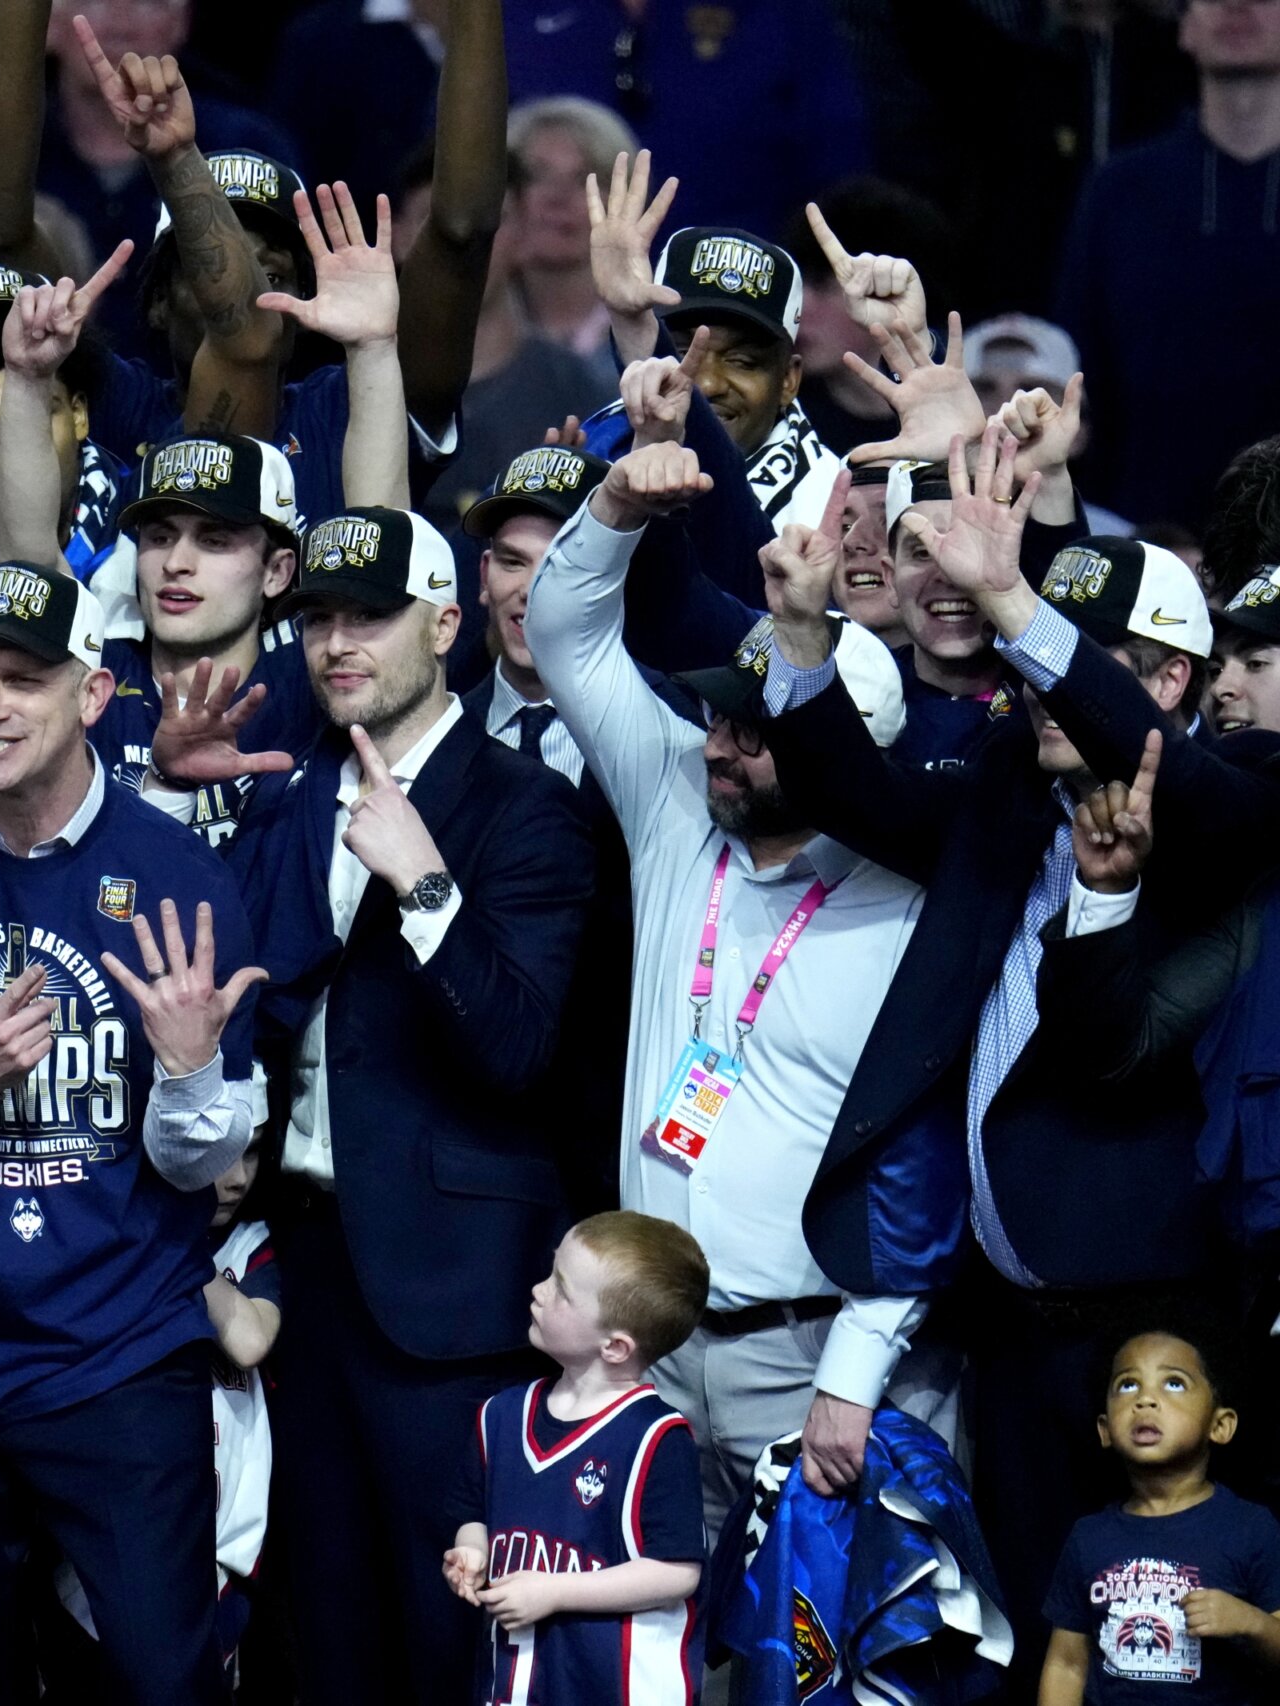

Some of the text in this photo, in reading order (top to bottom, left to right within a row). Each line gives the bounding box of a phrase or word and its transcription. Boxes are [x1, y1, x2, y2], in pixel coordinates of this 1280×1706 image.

[208, 159, 278, 198] HAMPS
[690, 239, 774, 294] CHAMPS
[151, 445, 233, 488] CHAMPS
[502, 455, 585, 490] CHAMPS
[306, 521, 381, 568] CHAMPS
[1040, 552, 1112, 598] CHAMPS
[104, 894, 128, 906] FOUR
[105, 885, 128, 896] FINAL
[706, 878, 724, 925] THE ROAD
[772, 910, 807, 958] PHX24
[29, 926, 114, 1016] BASKETBALL
[15, 1140, 27, 1153] OF
[1090, 1580, 1204, 1603] CHAMPION
[1106, 1572, 1191, 1586] 2023 NATIONAL
[1140, 1671, 1189, 1681] BASKETBALL
